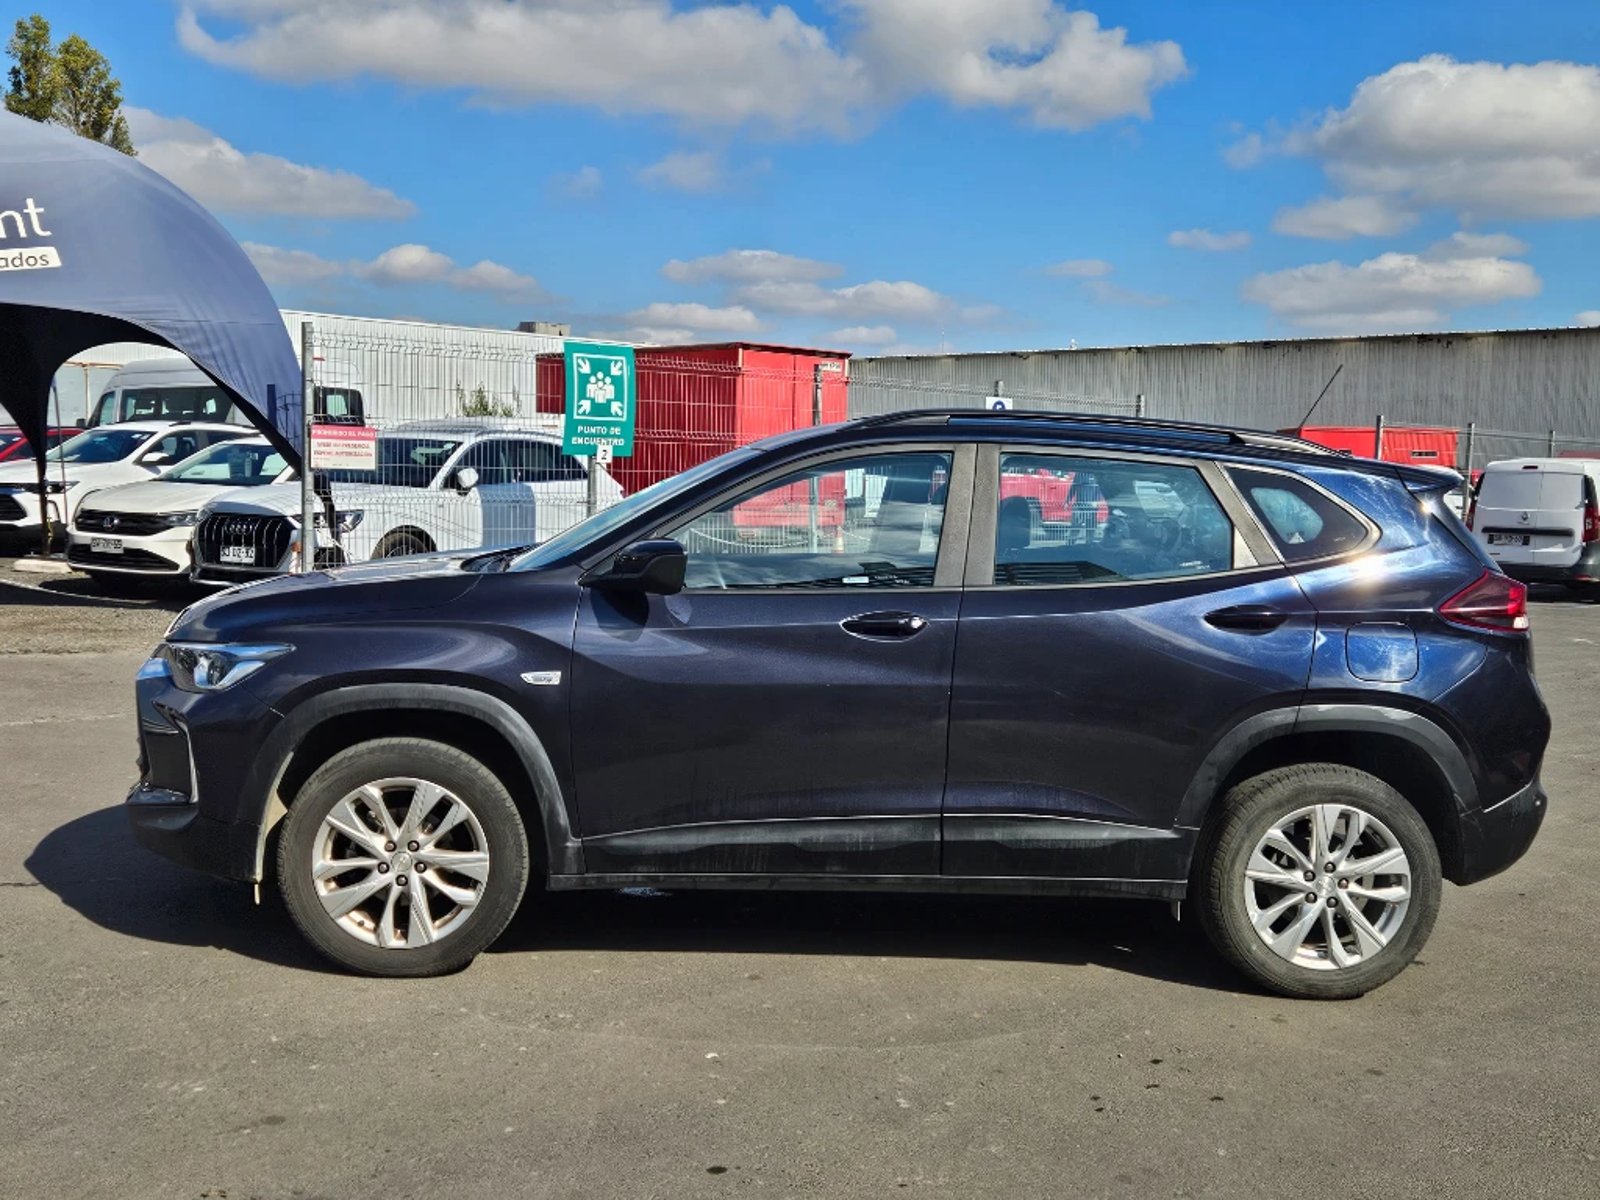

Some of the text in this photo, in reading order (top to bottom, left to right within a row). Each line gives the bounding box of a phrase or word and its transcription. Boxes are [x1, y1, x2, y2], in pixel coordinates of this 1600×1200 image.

[577, 425, 621, 435] PUNTO DE
[571, 437, 624, 446] ENCUENTRO
[601, 449, 608, 460] 2
